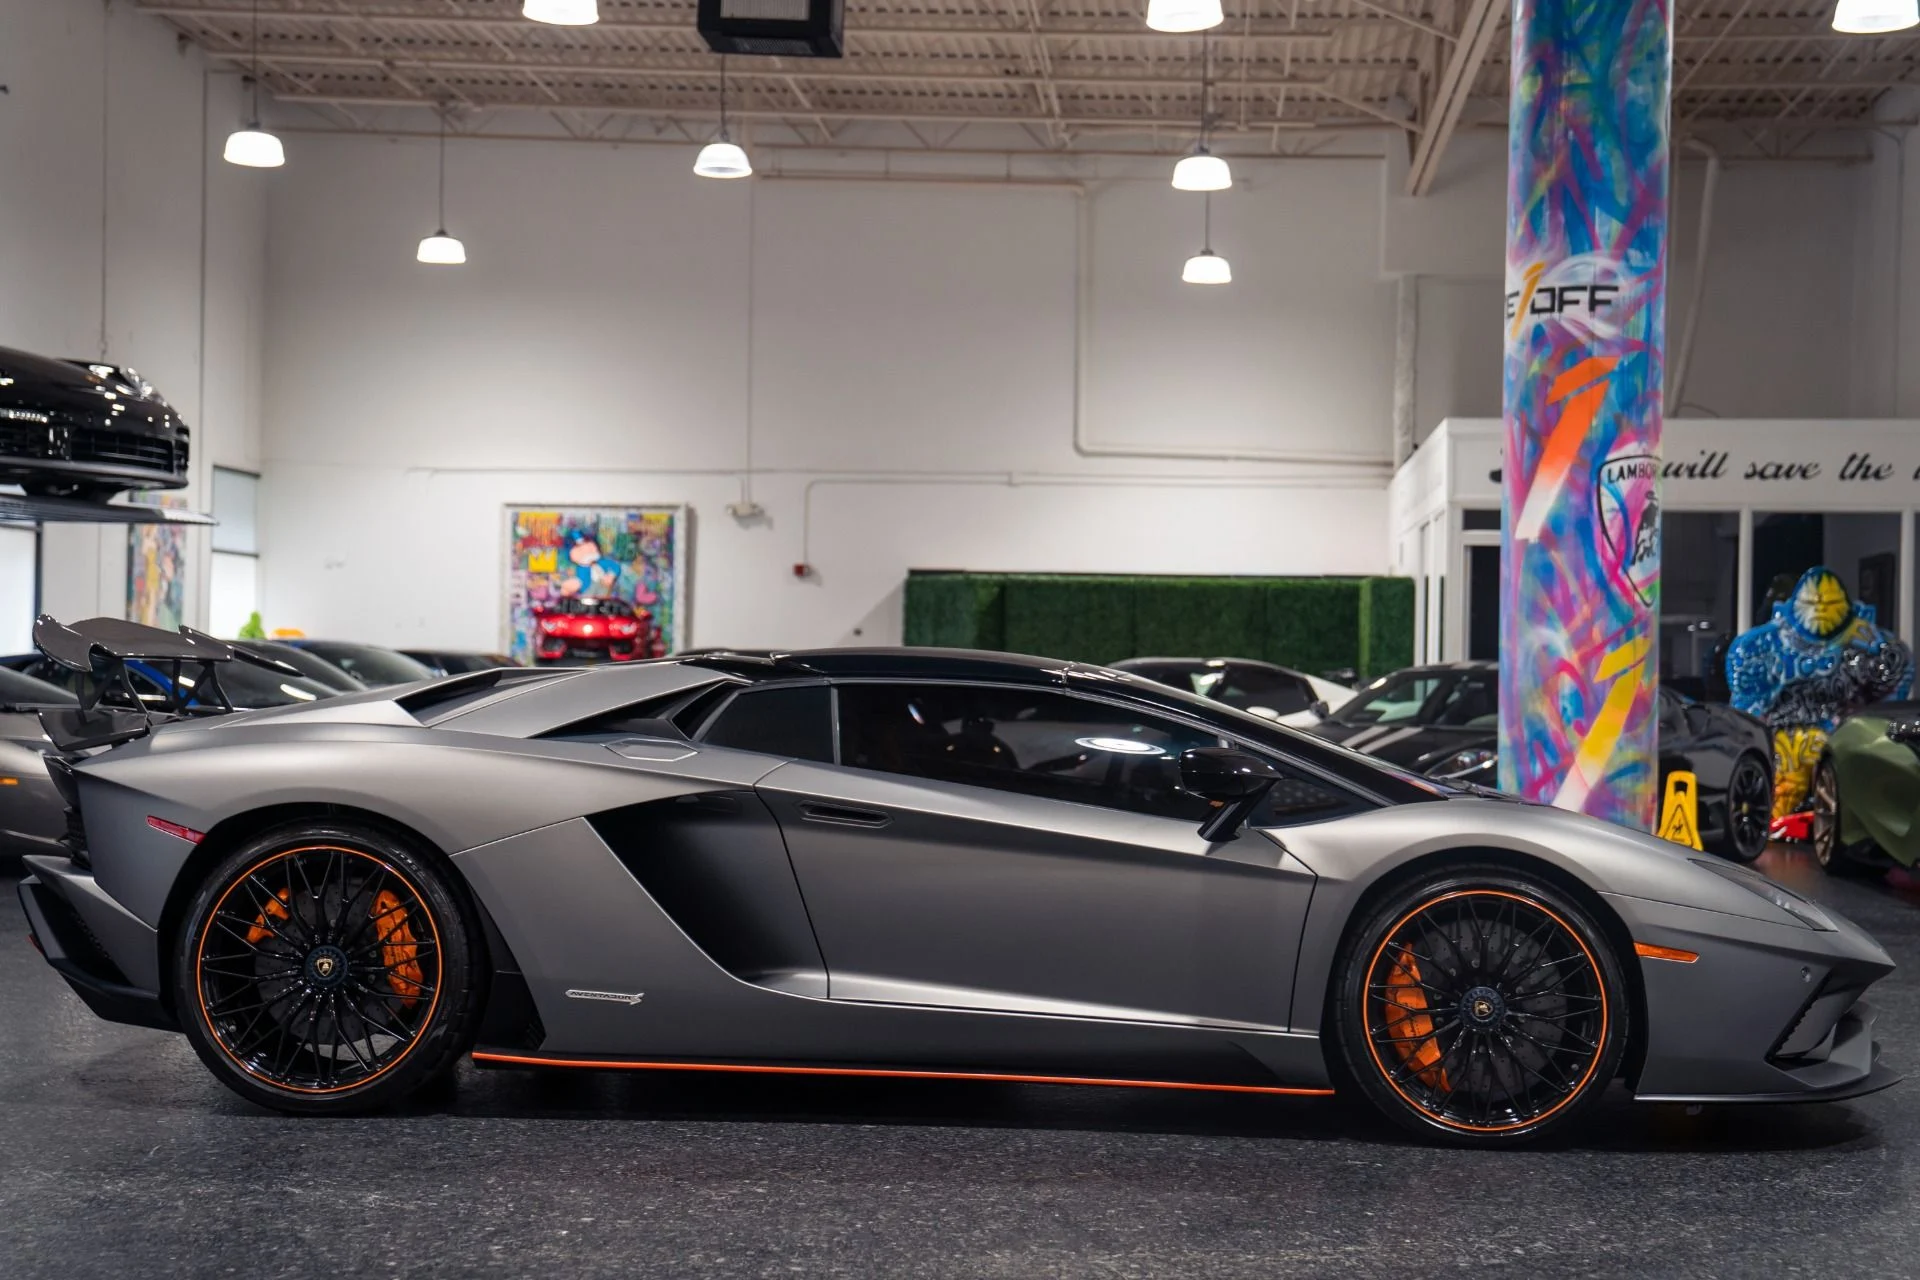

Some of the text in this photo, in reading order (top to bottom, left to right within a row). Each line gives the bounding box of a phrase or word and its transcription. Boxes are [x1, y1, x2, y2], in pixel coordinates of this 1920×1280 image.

[1662, 449, 1728, 479] will
[1744, 461, 1822, 481] save
[1838, 452, 1895, 480] the
